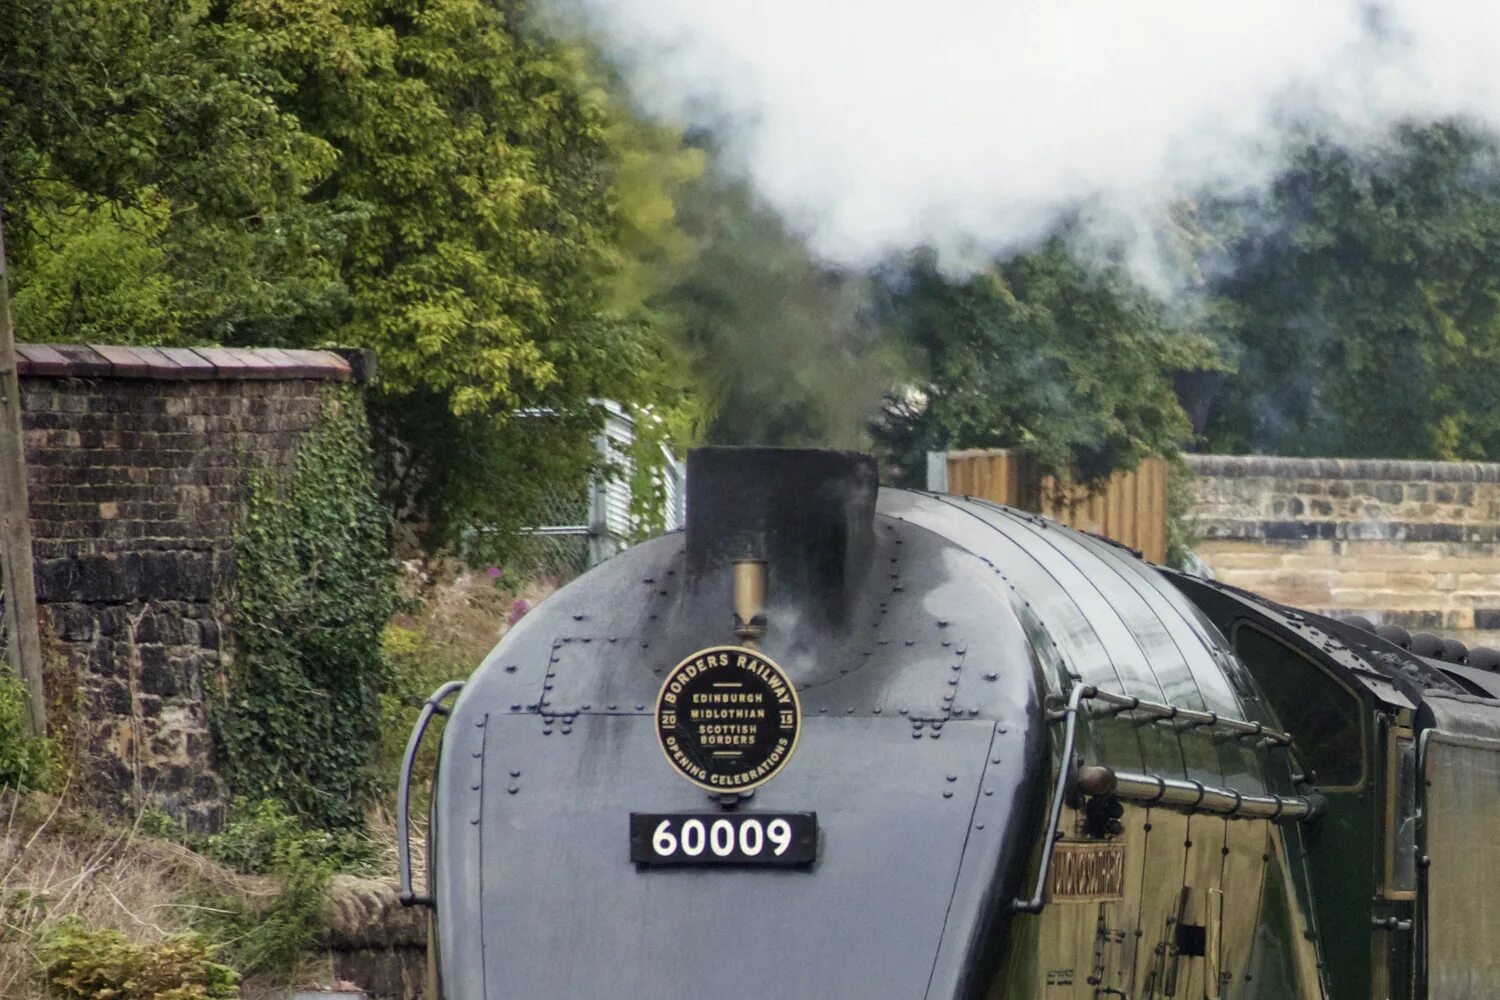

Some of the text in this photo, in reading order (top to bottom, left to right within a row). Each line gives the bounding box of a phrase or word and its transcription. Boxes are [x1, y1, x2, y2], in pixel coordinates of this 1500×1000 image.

[664, 653, 791, 704] BORDERS RAILWAY
[693, 694, 763, 703] EDINBURGH
[690, 709, 765, 718] MIDLOTHIAN
[662, 715, 676, 725] 20
[780, 714, 793, 725] 15
[699, 725, 757, 734] SCOTTISH
[700, 735, 756, 745] BORDERS
[666, 737, 788, 785] OPENING CELEBRATIONS
[652, 818, 792, 857] 60009
